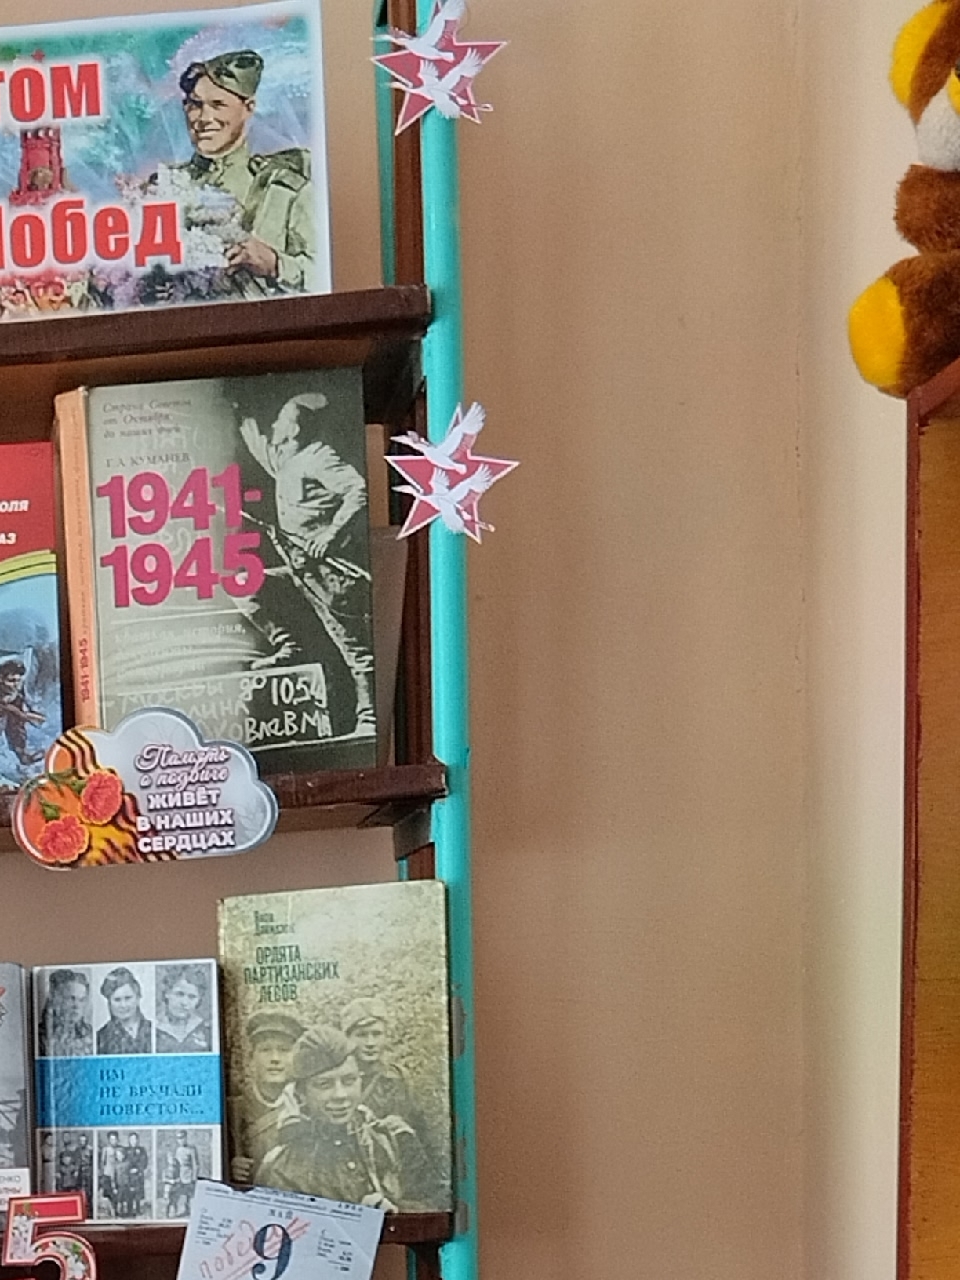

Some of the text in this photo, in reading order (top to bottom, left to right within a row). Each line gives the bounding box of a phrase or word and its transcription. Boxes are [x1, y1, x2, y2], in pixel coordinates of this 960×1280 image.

[100, 532, 266, 608] 1945
[135, 744, 230, 771] Память
[156, 767, 229, 791] подвиге
[147, 786, 220, 811] ЖИВЁТ
[136, 808, 234, 832] В НАШИХ
[137, 830, 235, 853] СЕРДЦАХ
[244, 961, 340, 984] ПАРТИЗАНСКИХ
[100, 1084, 202, 1098] НЕ ВРУЧАЛИ
